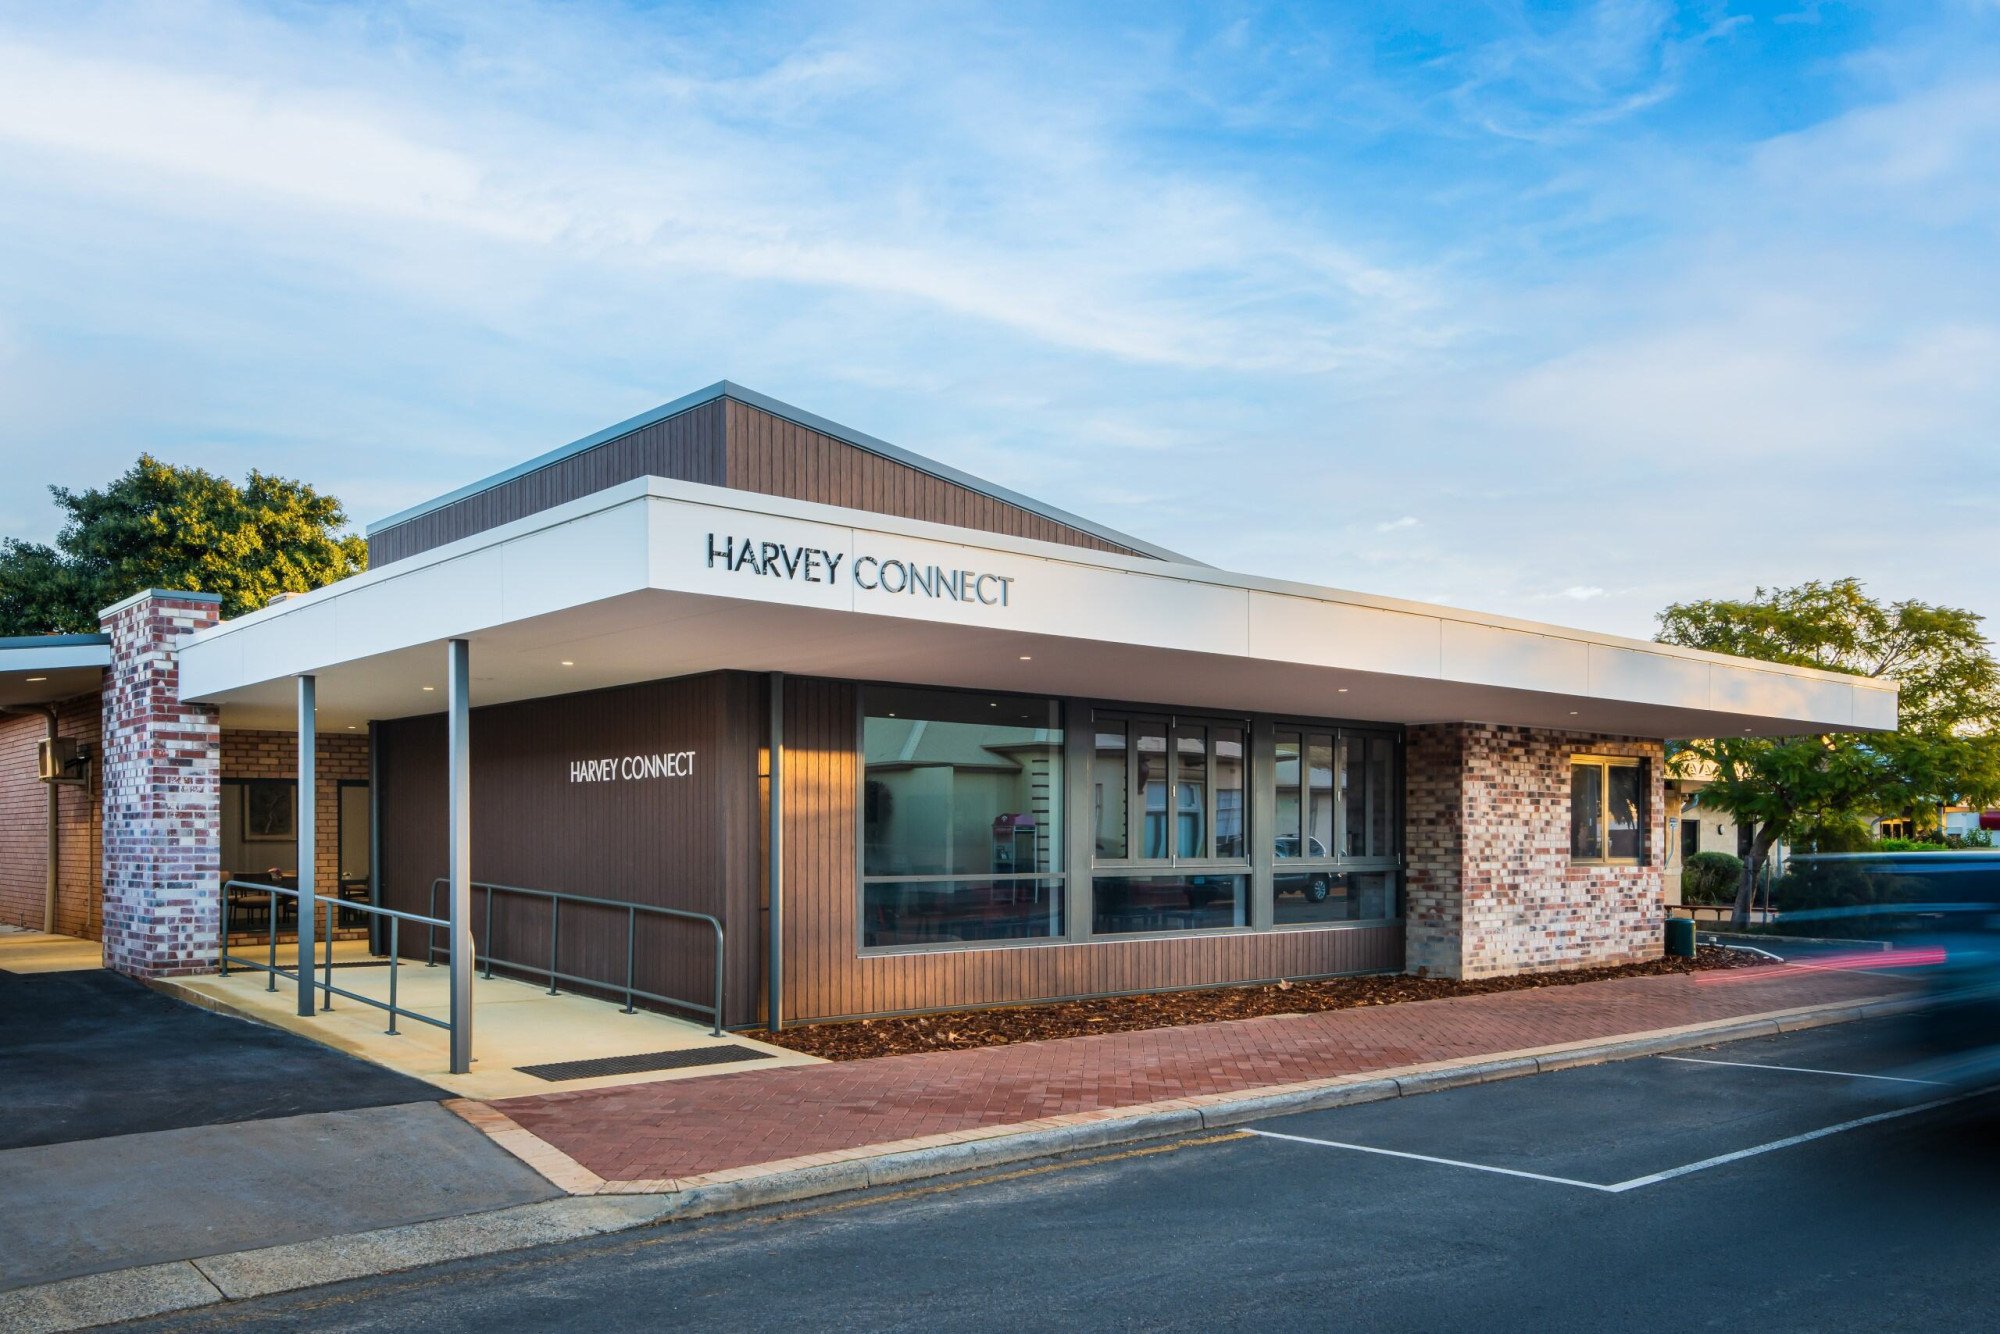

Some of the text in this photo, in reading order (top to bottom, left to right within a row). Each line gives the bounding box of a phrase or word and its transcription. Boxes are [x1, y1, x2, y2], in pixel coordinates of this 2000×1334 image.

[708, 533, 1014, 606] HARVEY CONNECT
[570, 751, 696, 783] HARVEY CONNECT
